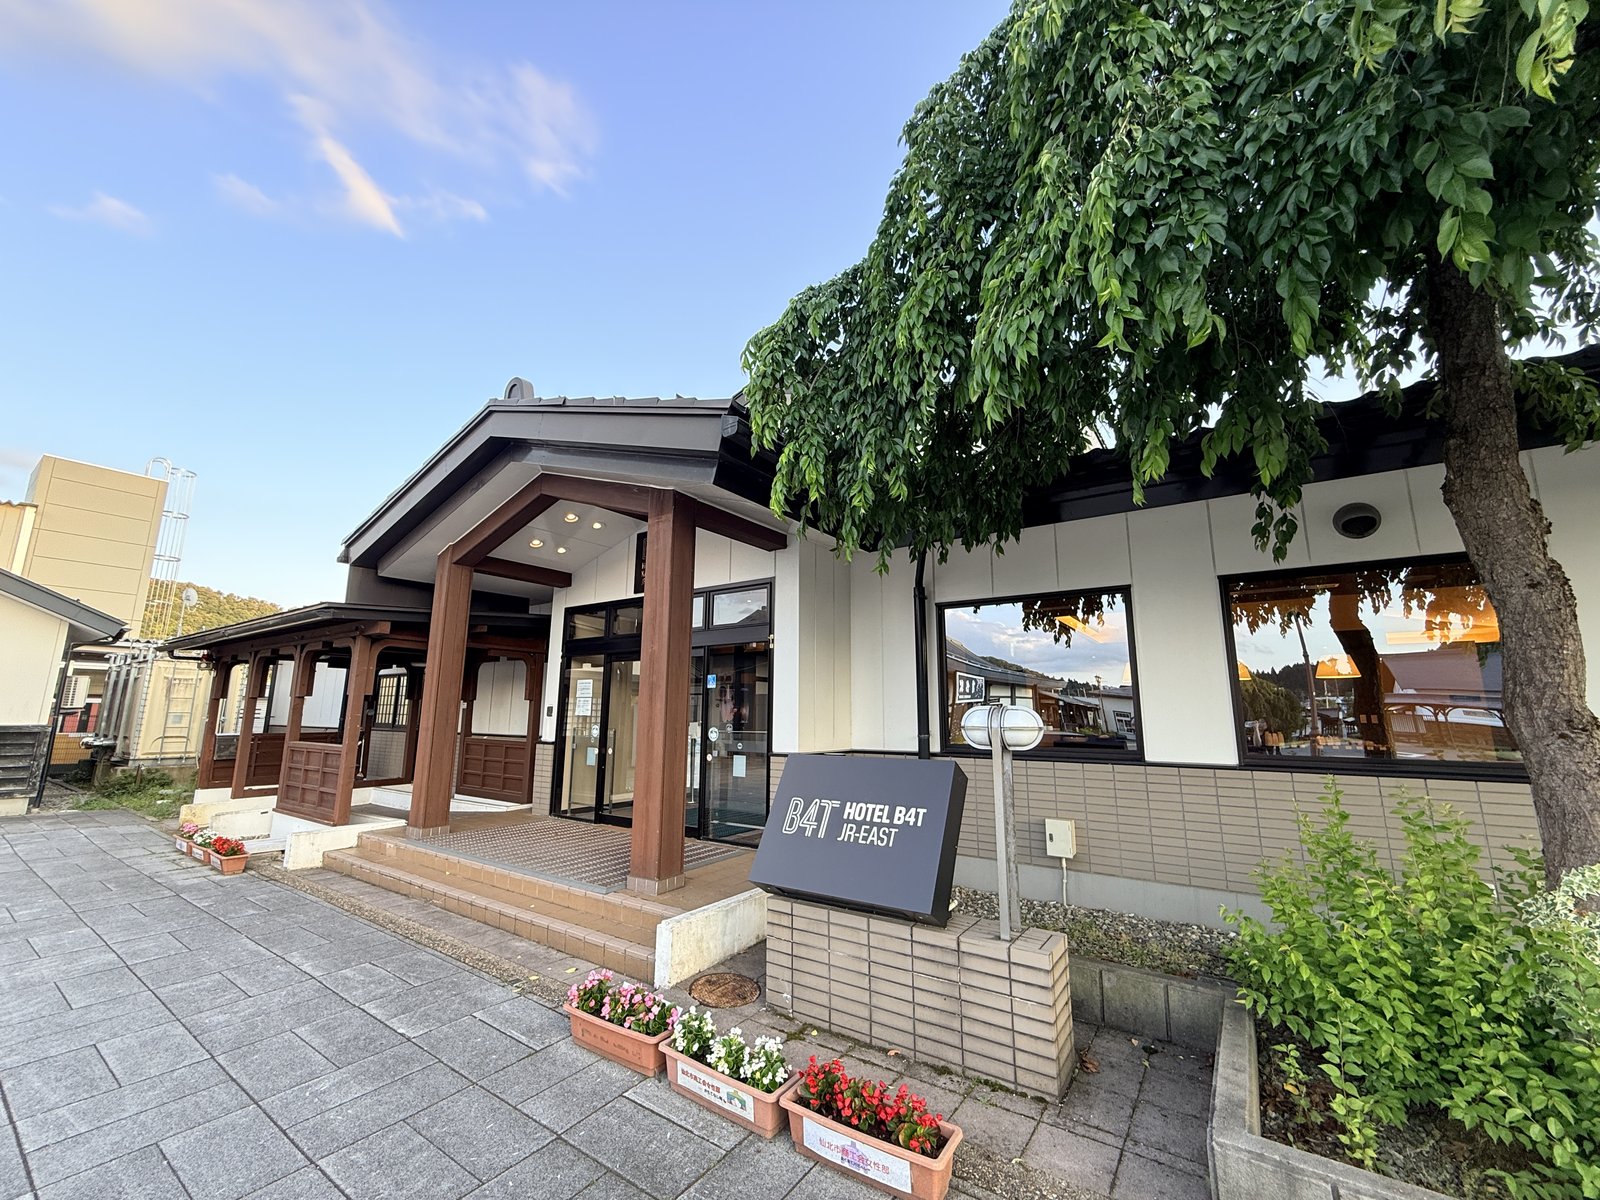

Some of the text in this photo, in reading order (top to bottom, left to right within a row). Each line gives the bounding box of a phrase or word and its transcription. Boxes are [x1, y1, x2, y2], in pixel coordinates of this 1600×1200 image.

[782, 797, 840, 839] B4T
[843, 802, 927, 827] HOTEL B4T
[837, 823, 898, 847] JR-EAST
[819, 1136, 890, 1175] 仙北市商工会女性部
